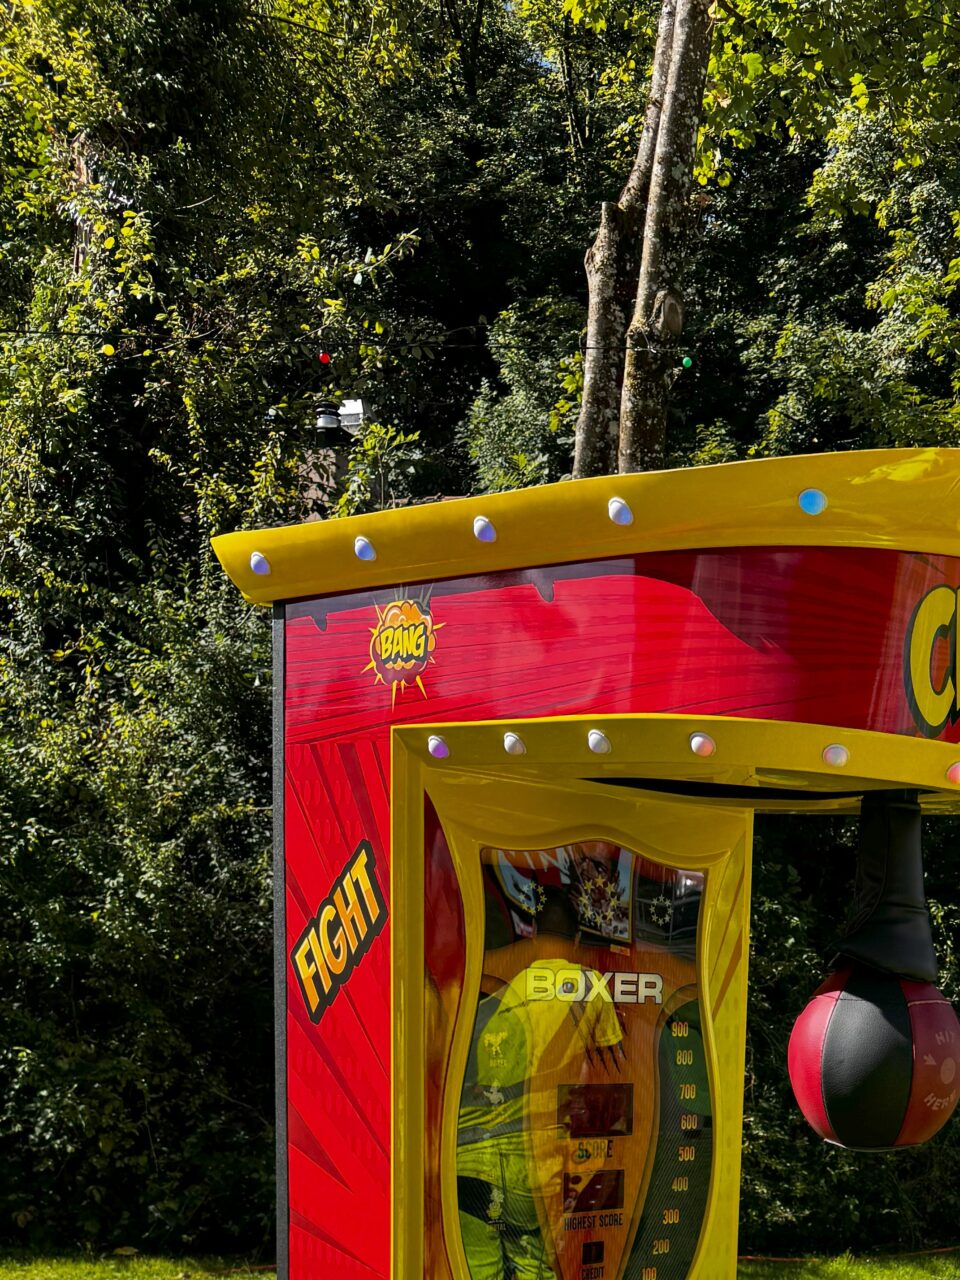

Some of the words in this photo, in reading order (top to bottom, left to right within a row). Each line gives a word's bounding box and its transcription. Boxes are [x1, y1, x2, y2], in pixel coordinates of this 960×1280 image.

[380, 623, 428, 663] BANG
[294, 848, 381, 1014] FIGHT
[526, 967, 663, 1004] BOXER
[671, 1021, 689, 1038] 900
[676, 1049, 693, 1065] 800
[679, 1083, 696, 1100] 700
[680, 1114, 698, 1130] 600
[577, 1139, 614, 1160] SCORE
[678, 1146, 695, 1162] 500
[671, 1176, 689, 1192] 400
[564, 1215, 597, 1231] HIGHEST
[599, 1212, 624, 1228] SCORE
[662, 1208, 680, 1225] 300
[652, 1238, 670, 1255] 200
